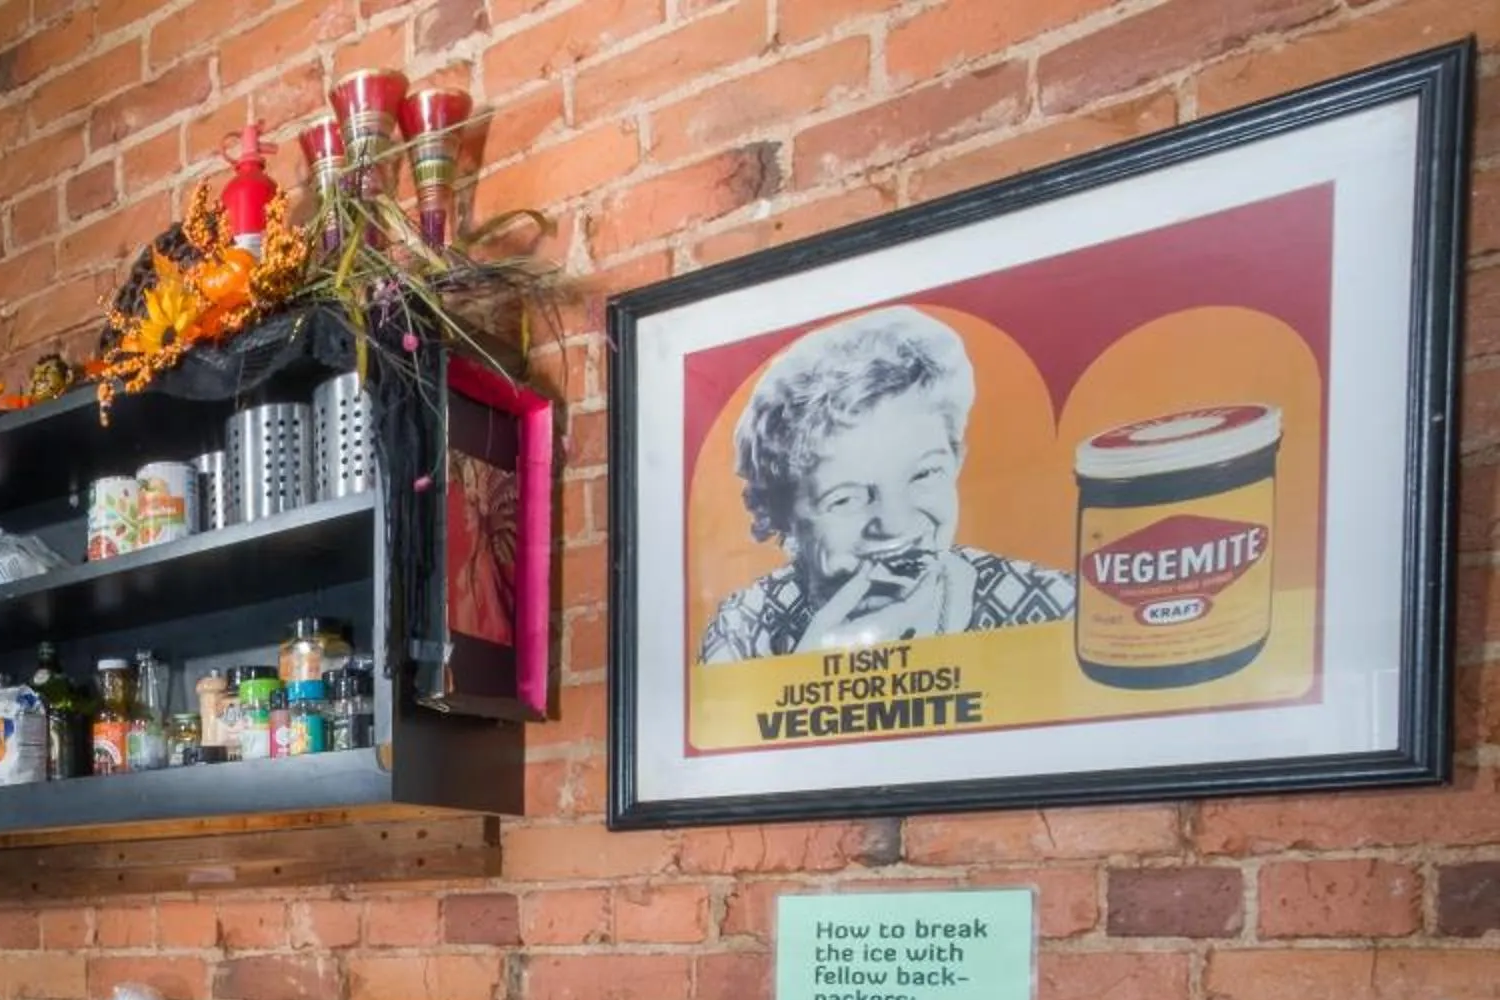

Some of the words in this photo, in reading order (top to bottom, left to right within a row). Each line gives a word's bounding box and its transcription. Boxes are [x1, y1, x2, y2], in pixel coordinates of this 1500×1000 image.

[1093, 527, 1261, 583] VEGEMITE
[1149, 602, 1200, 619] KRAFT
[823, 654, 841, 676] IT
[850, 646, 910, 673] ISN'T
[776, 682, 833, 707] JUST
[838, 675, 886, 700] FOR
[892, 666, 961, 695] KIDS!
[757, 692, 983, 740] VEGEMITE
[816, 921, 870, 940] How
[879, 923, 905, 939] to
[915, 919, 988, 939] break
[815, 944, 853, 962] the
[863, 944, 897, 962] ice
[905, 943, 964, 962] with
[814, 966, 888, 985] fellow
[896, 966, 970, 986] back-
